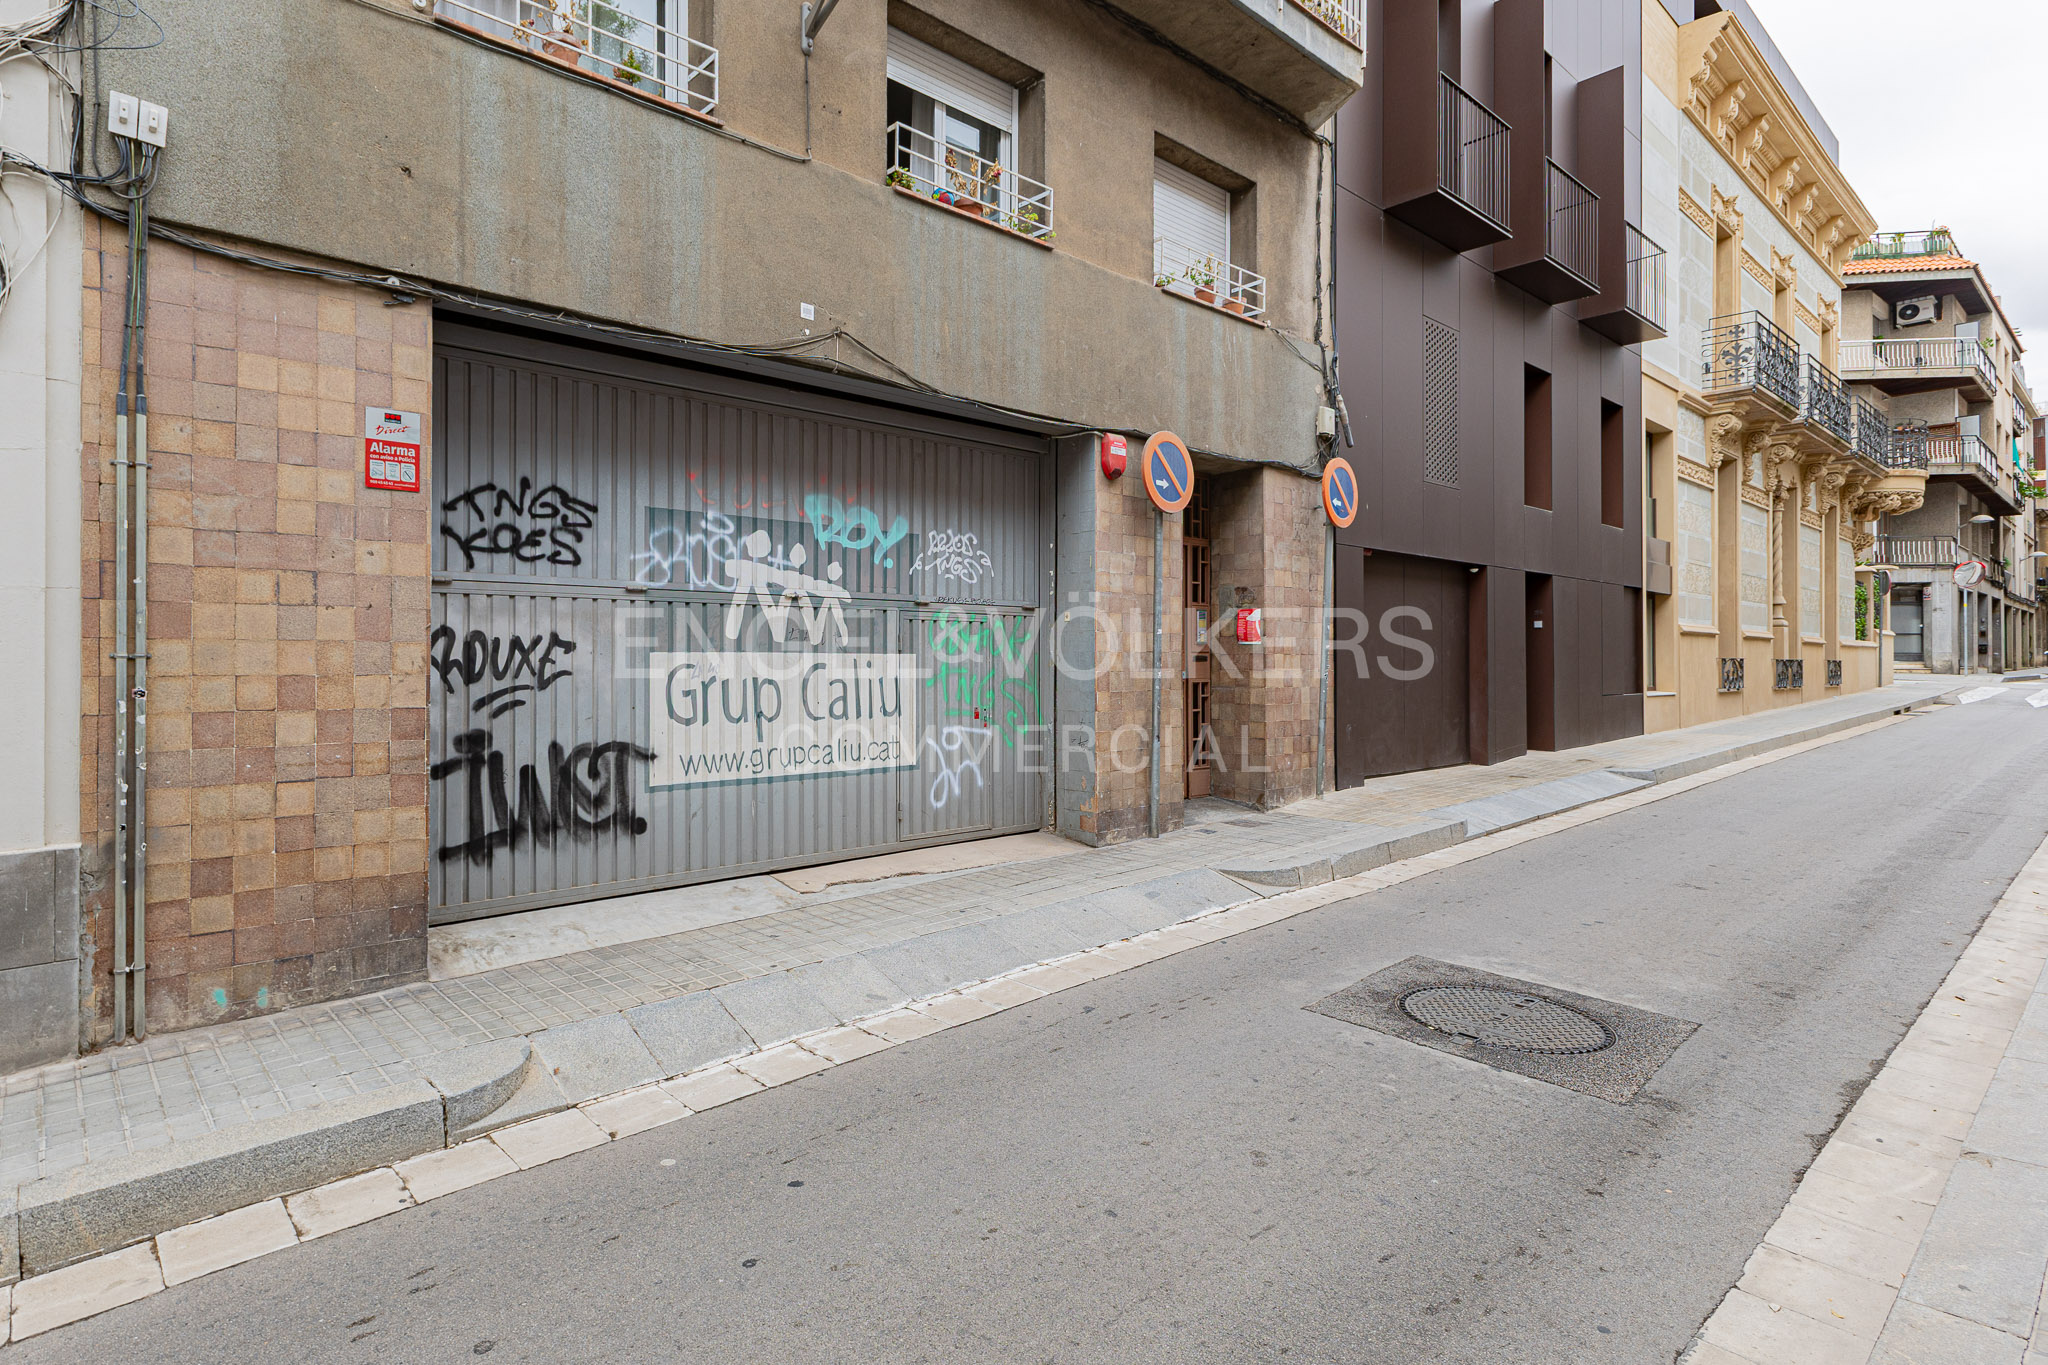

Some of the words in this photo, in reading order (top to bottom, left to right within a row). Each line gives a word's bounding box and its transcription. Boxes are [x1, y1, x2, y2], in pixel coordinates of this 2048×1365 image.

[375, 424, 411, 436] Direct
[370, 441, 415, 457] Alarma
[665, 662, 783, 743] Grup
[801, 658, 902, 721] Caliu
[680, 736, 901, 776] www.grupcaliu.cat
